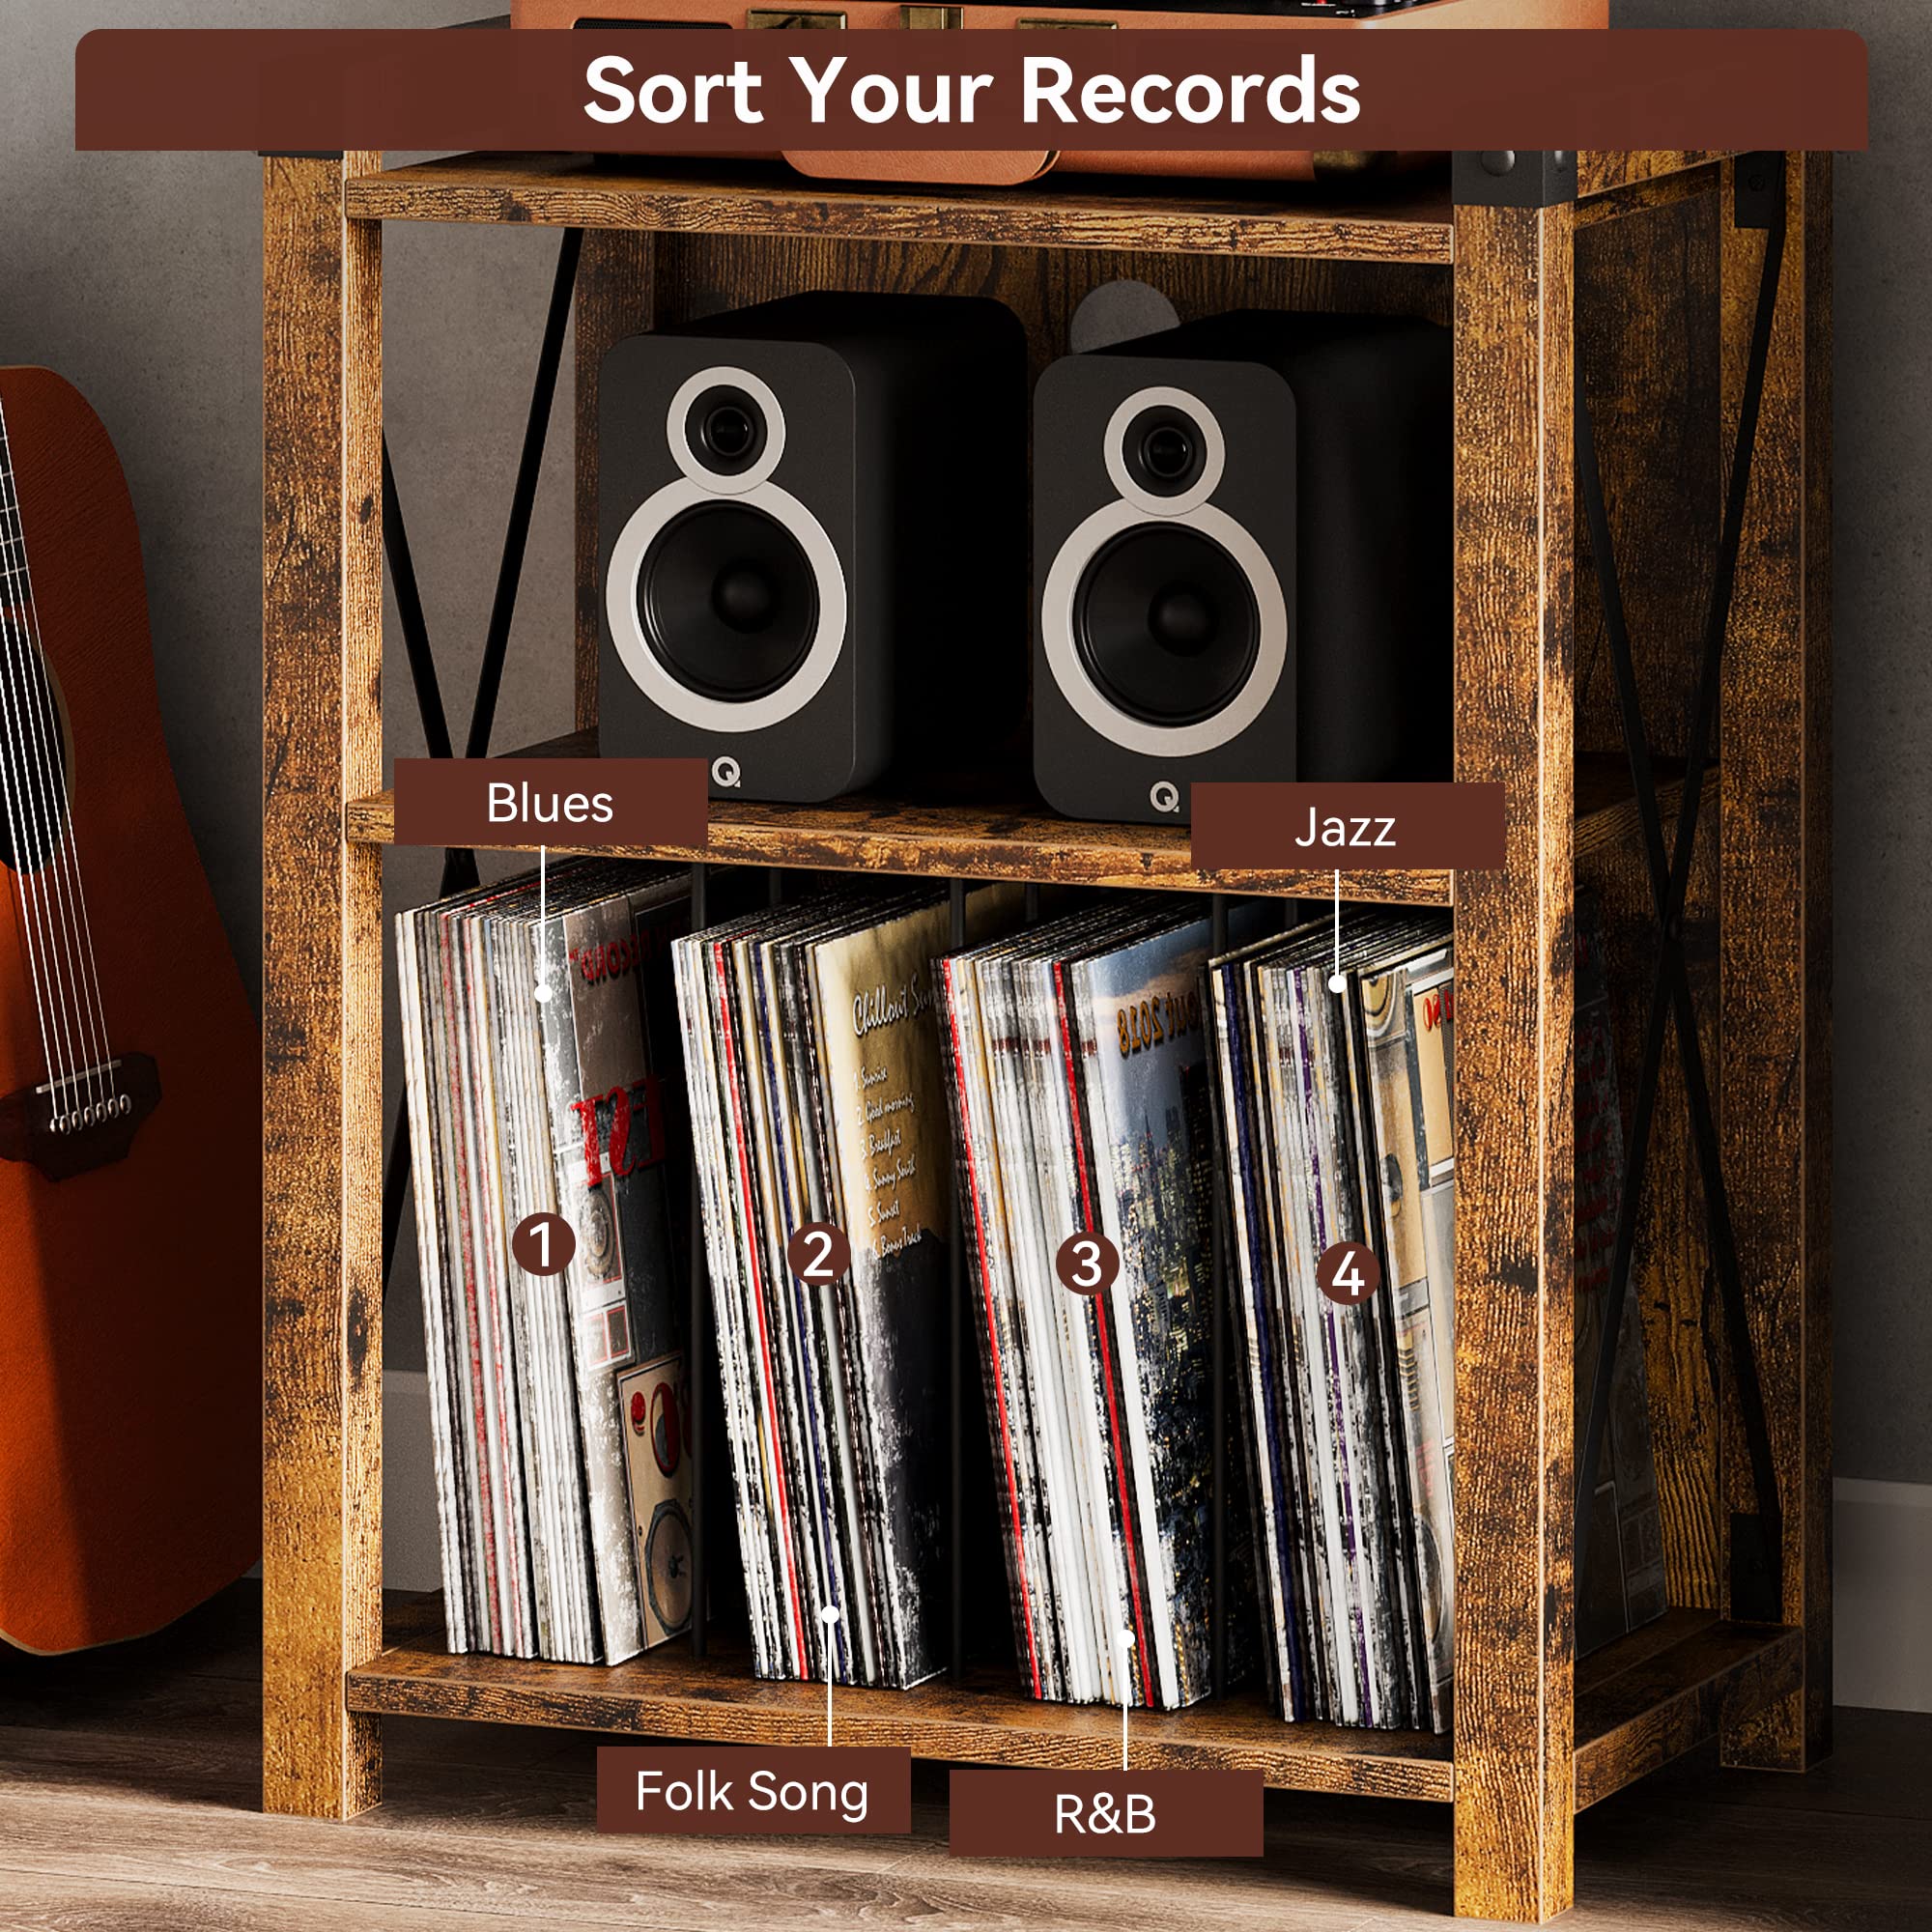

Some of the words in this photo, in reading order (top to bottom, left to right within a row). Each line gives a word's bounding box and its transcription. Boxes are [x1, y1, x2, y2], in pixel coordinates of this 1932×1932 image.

[711, 756, 741, 788] Q
[1150, 781, 1179, 812] Q
[853, 984, 908, 1036] Chillout
